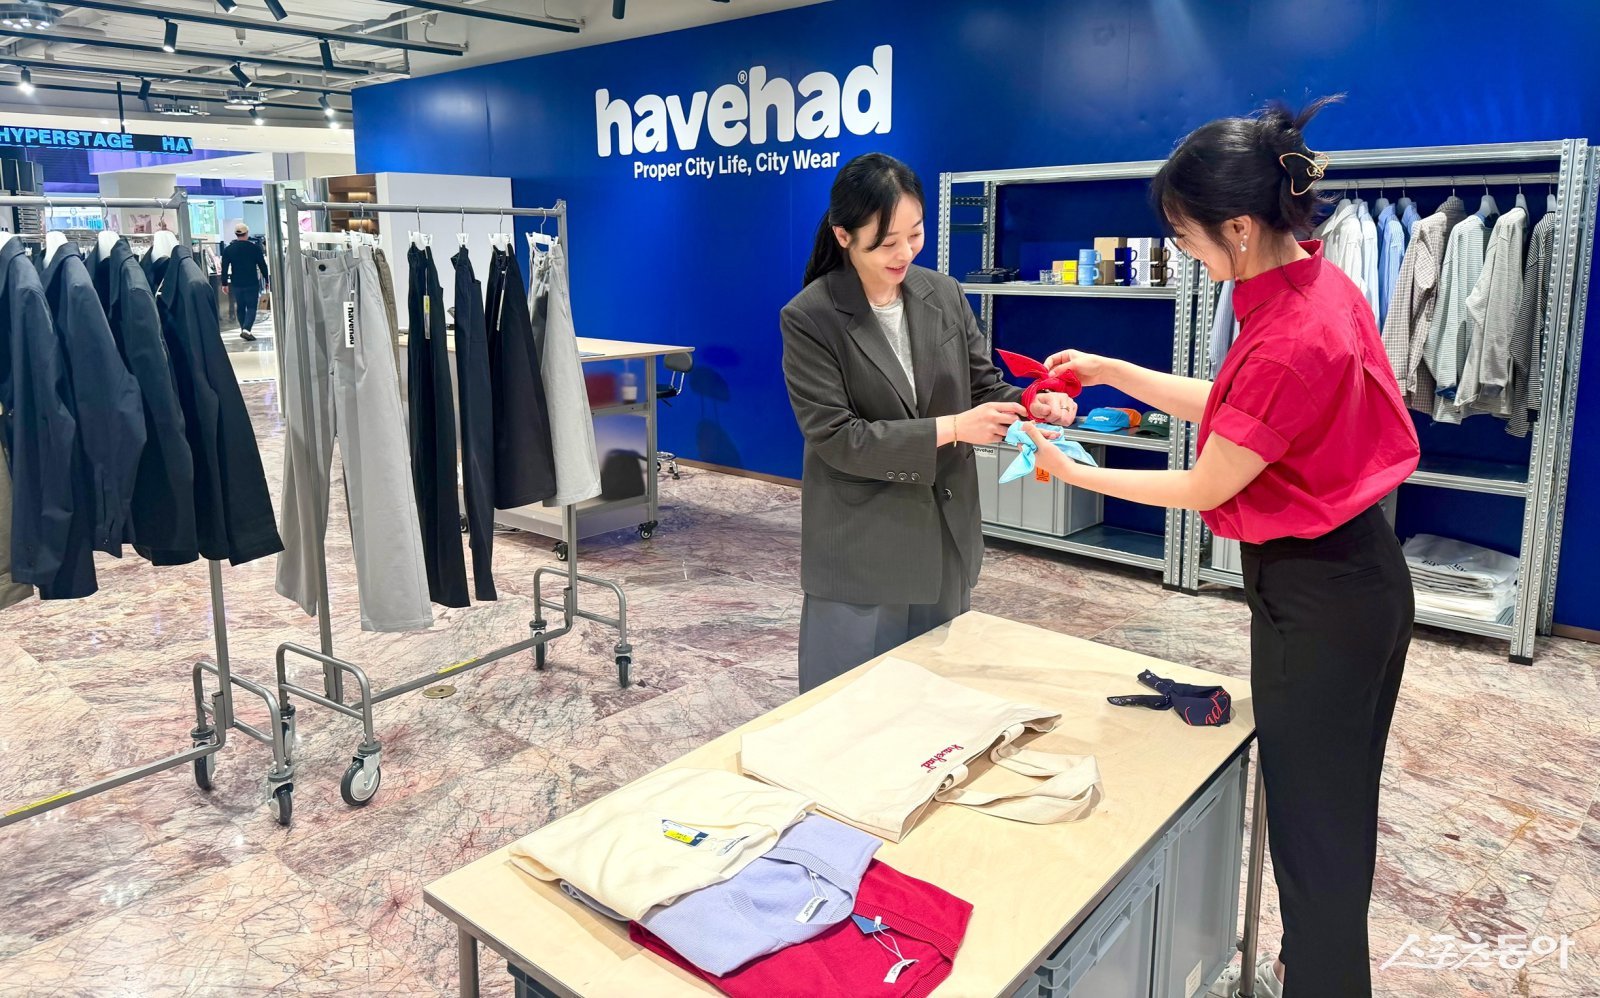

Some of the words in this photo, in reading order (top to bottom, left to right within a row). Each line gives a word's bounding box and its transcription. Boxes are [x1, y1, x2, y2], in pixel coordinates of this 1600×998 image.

[0, 127, 133, 148] HYPERSTAGE
[634, 161, 682, 181] Proper
[685, 157, 715, 179] City
[719, 154, 752, 176] Life,
[756, 153, 789, 174] City
[792, 149, 841, 170] Wear
